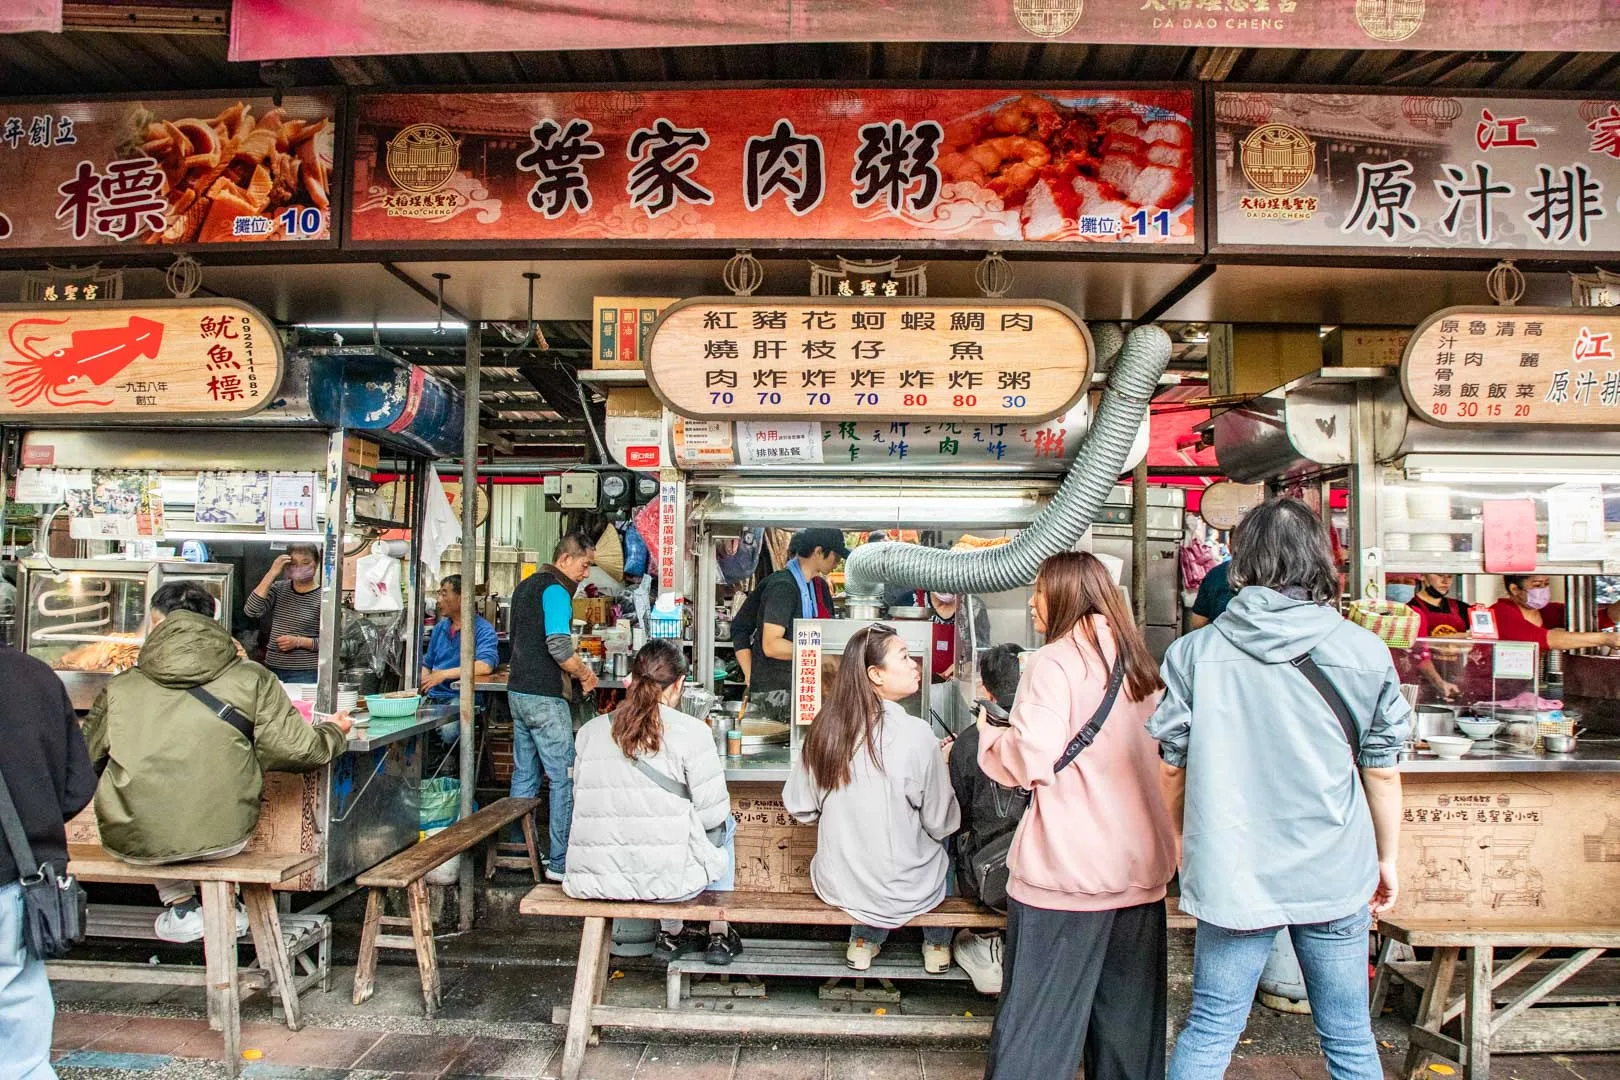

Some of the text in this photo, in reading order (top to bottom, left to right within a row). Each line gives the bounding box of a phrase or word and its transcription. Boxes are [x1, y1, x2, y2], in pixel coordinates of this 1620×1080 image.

[1153, 17, 1285, 30] DA DAO CHENG
[4, 116, 77, 149] 年創立
[518, 119, 943, 218] 葉家肉粥
[1344, 160, 1604, 243] 原汁排
[280, 208, 321, 235] 10
[1131, 210, 1169, 236] 11
[837, 279, 900, 297] 慈聖宮
[1574, 329, 1613, 361] 江
[200, 315, 245, 402] 魷魚標
[241, 317, 259, 397] 0922111682
[115, 381, 168, 393] 一九五八年
[136, 395, 157, 406] 創立
[709, 392, 734, 405] 70
[757, 392, 781, 405] 70
[806, 393, 831, 405] 70
[854, 393, 879, 406] 70
[903, 394, 928, 406] 80
[953, 395, 977, 407] 80
[1002, 395, 1026, 408] 30
[1432, 403, 1448, 415] 80
[1457, 402, 1478, 417] 30
[1487, 404, 1502, 416] 15
[1514, 404, 1530, 416] 20
[756, 447, 801, 458] 排隊點餐
